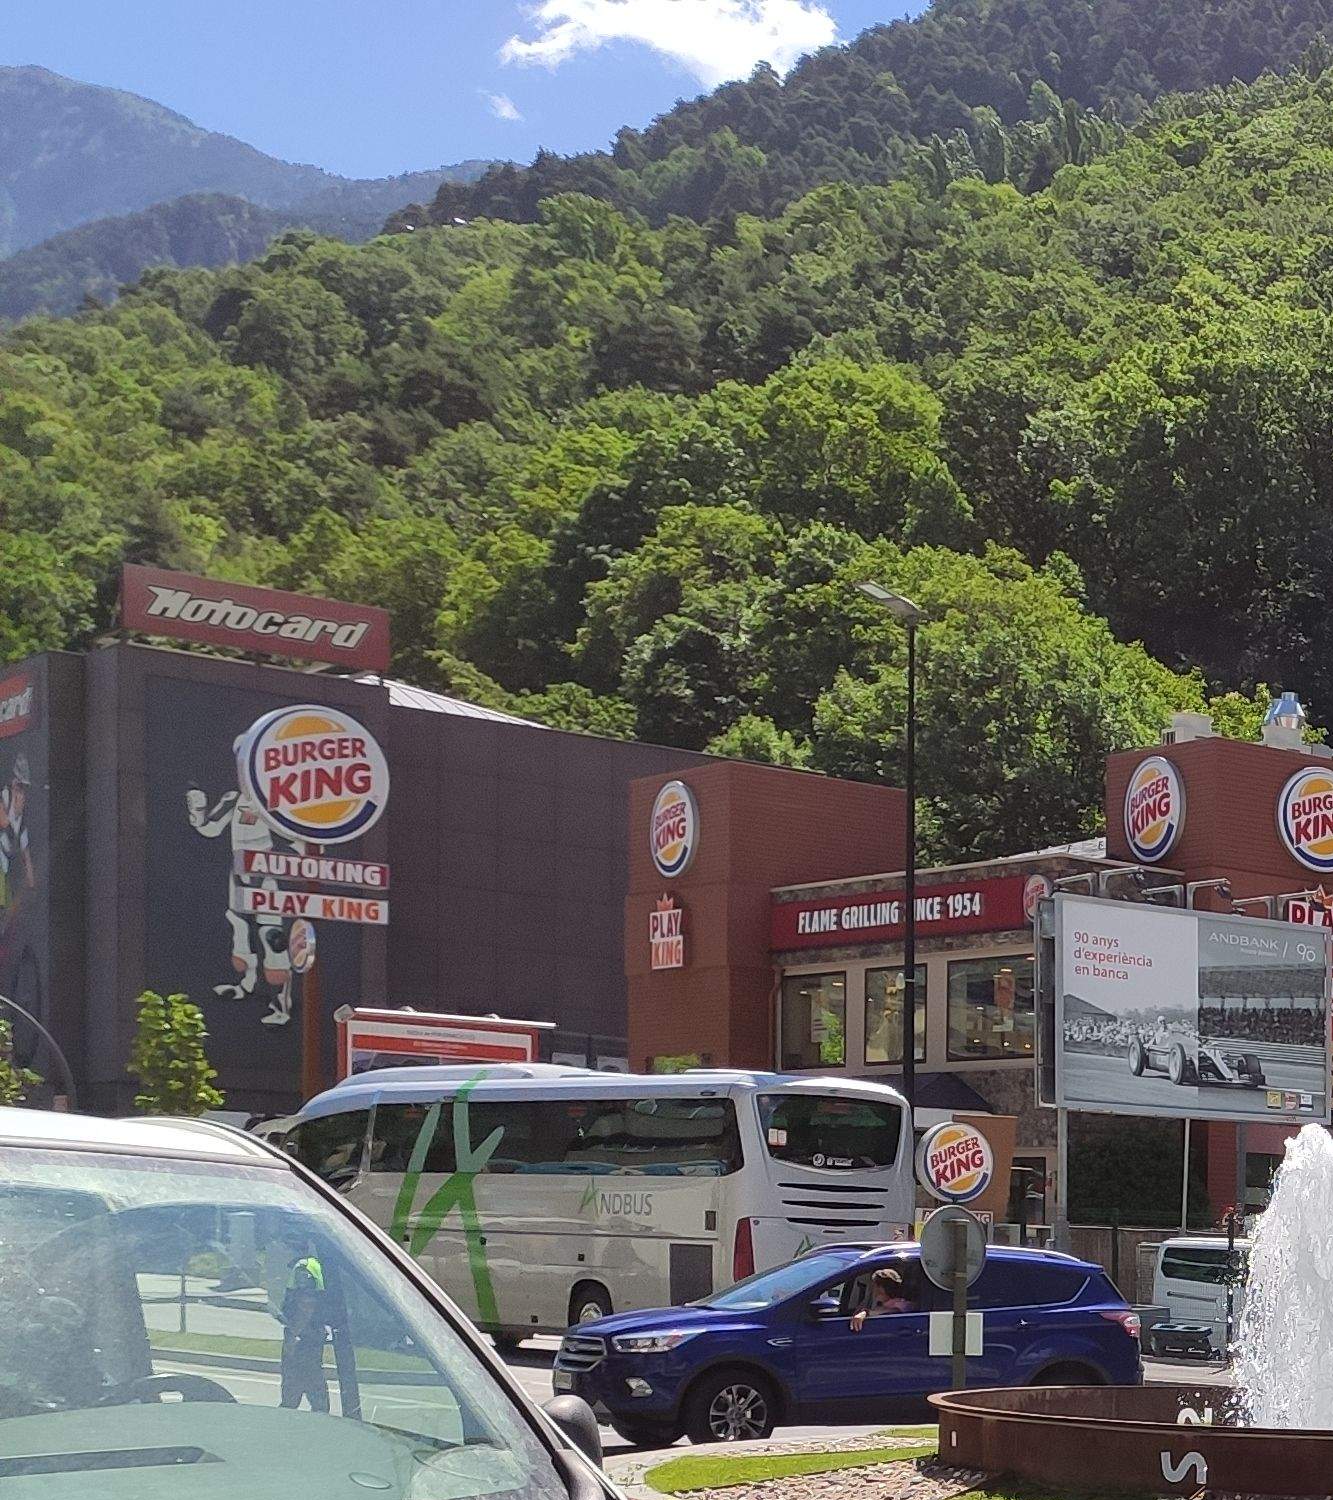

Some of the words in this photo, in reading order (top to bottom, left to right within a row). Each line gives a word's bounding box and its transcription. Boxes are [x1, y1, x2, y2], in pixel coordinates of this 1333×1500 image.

[264, 737, 367, 772] BURGER
[267, 762, 371, 809] KING
[1130, 775, 1169, 815] BURGER
[1131, 792, 1171, 841] KING
[655, 817, 686, 852] KING
[251, 853, 382, 886] AUTOKING
[252, 891, 310, 914] PLAY
[322, 899, 380, 921] KING
[797, 908, 838, 935] FLAME
[841, 901, 900, 930] GRILLING
[914, 896, 941, 922] INCE
[947, 892, 981, 919] 1954
[652, 911, 680, 939] PLAY
[1074, 931, 1089, 944] 90
[1092, 935, 1119, 949] anys
[1209, 932, 1279, 950] ANDBANK
[653, 940, 681, 967] KING
[1074, 966, 1089, 976] en
[1093, 965, 1129, 981] banca
[930, 1136, 981, 1170] BURGER
[934, 1149, 985, 1190] KING
